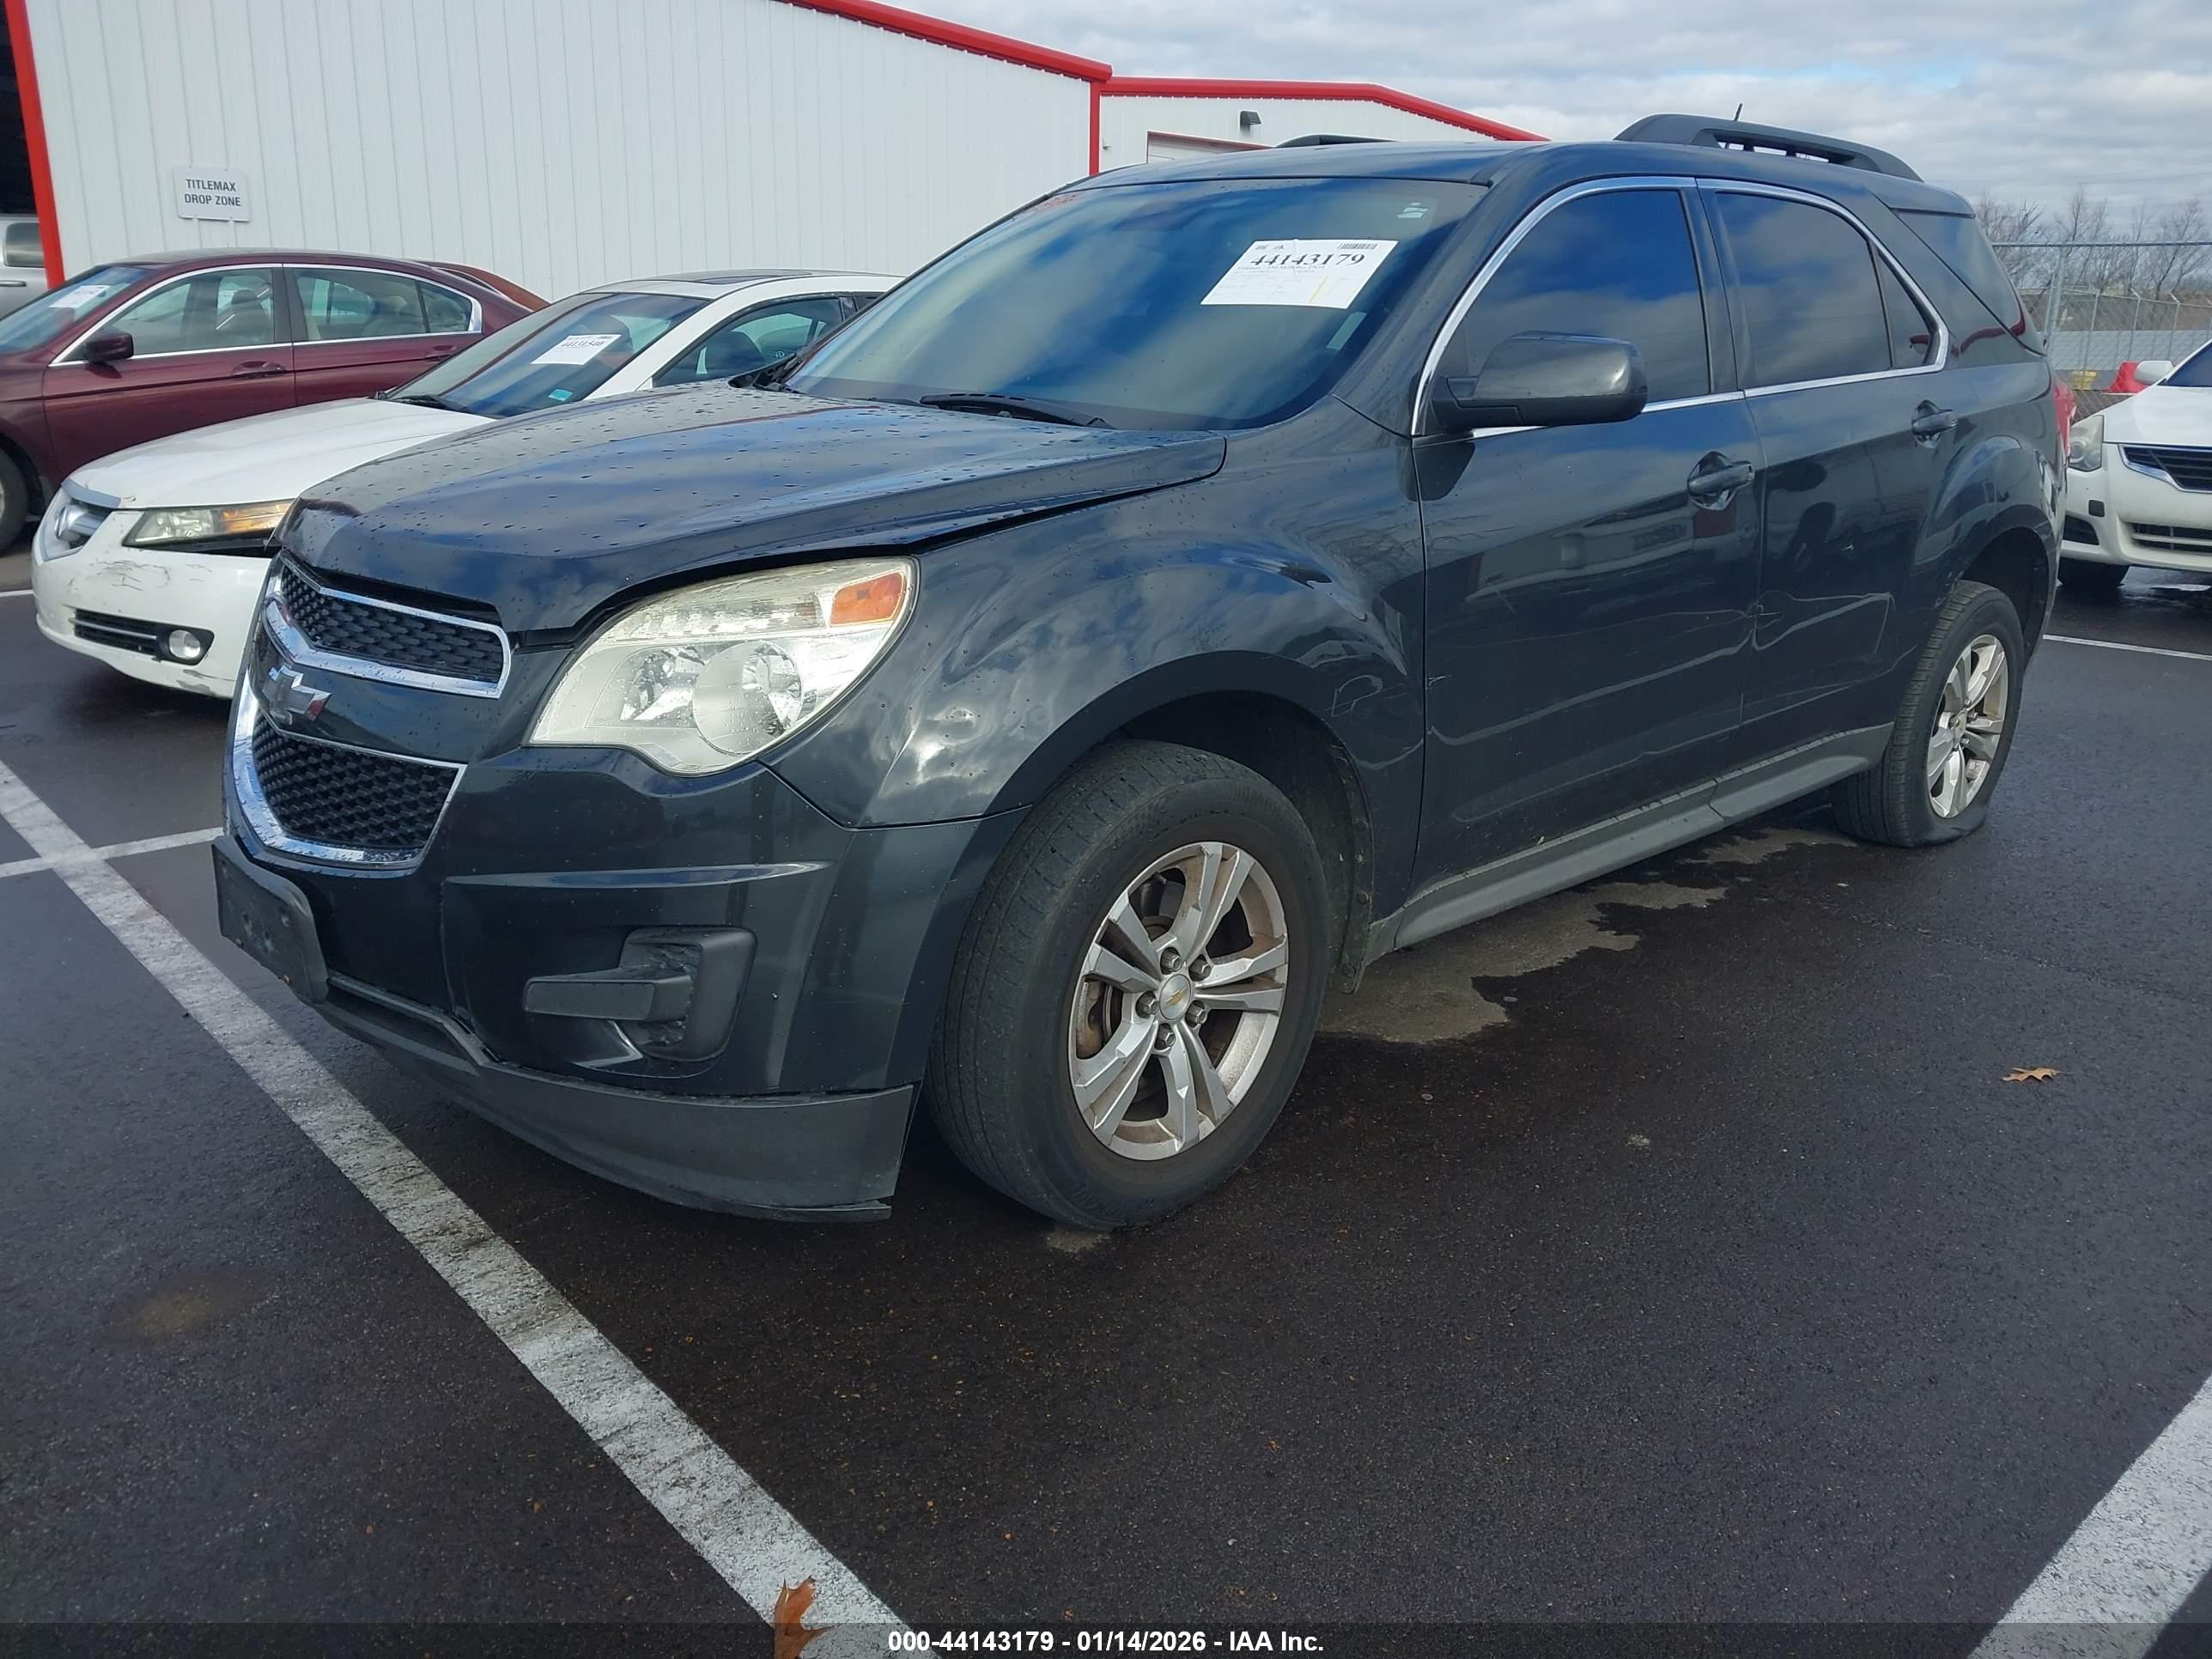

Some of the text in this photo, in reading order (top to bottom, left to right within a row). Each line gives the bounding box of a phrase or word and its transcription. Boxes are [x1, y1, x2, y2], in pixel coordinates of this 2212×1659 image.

[185, 179, 236, 191] TITLEMAX
[184, 193, 241, 206] DROP ZONE
[1249, 253, 1365, 266] 44143179
